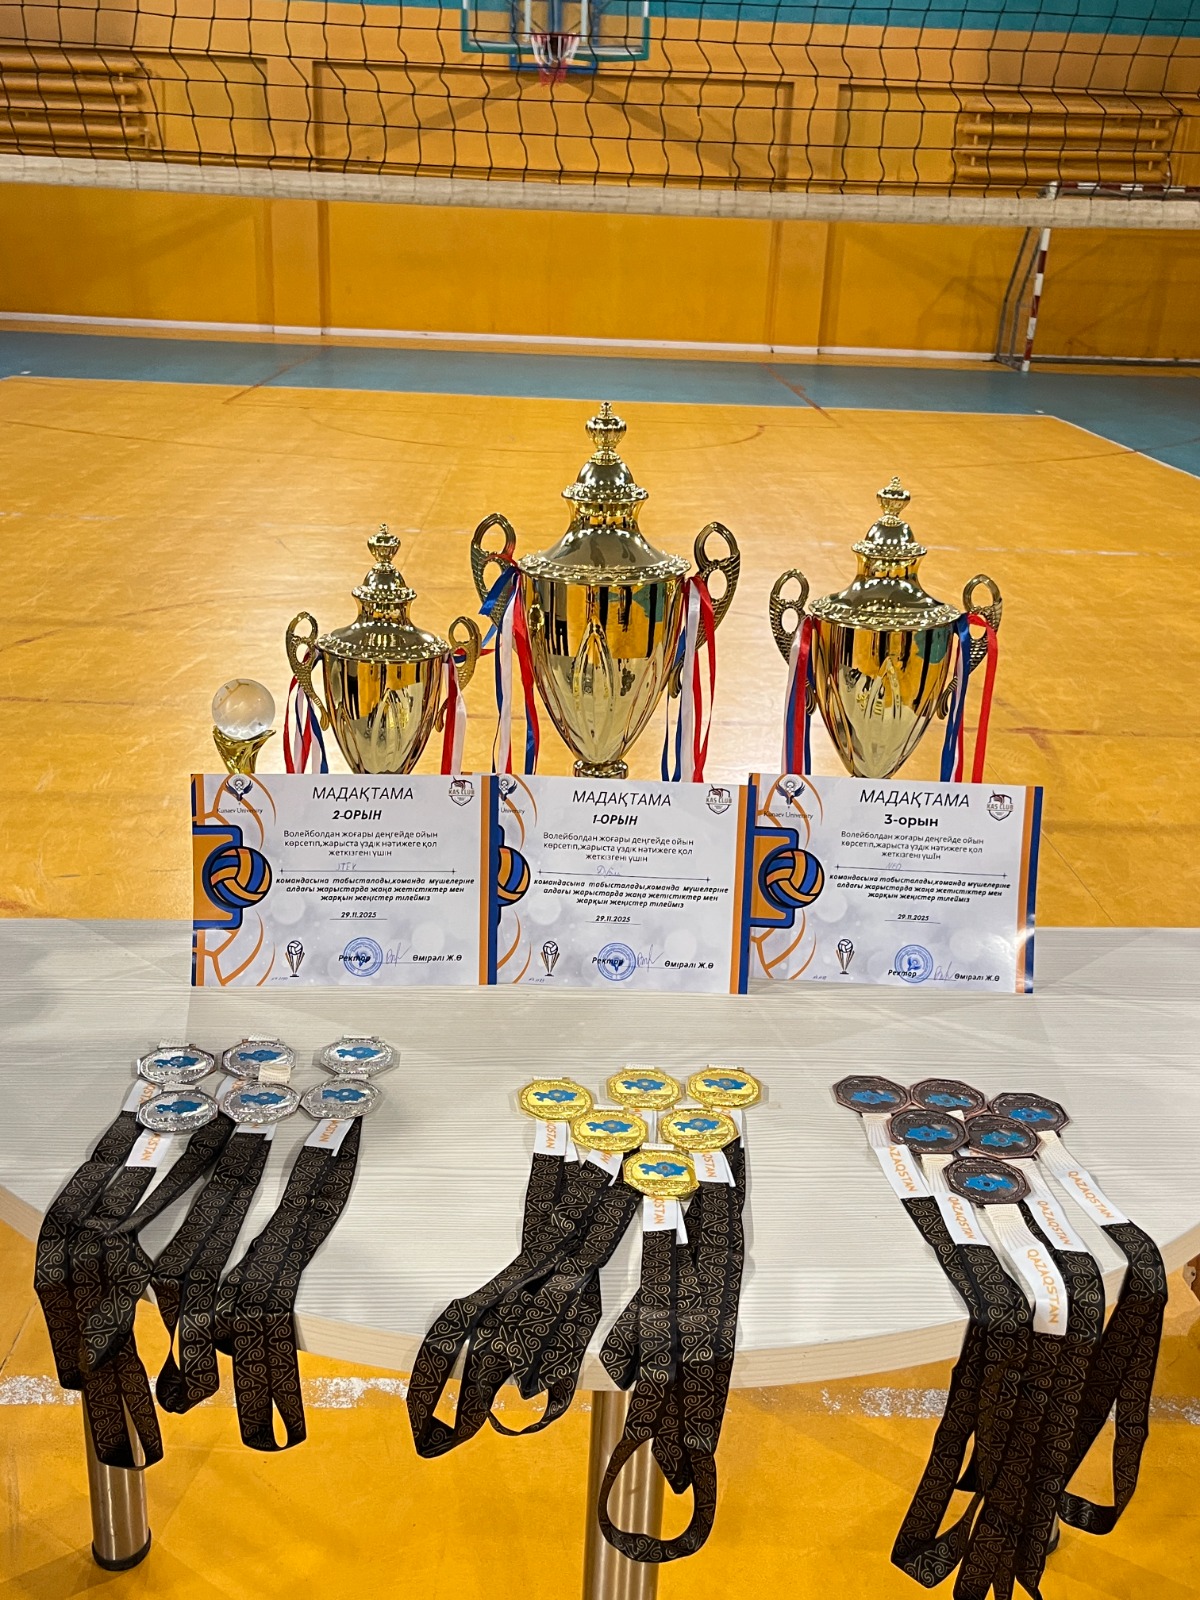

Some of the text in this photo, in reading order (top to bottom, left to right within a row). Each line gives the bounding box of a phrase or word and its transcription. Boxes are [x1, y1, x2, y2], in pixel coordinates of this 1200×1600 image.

[312, 787, 414, 802] МАДАҚТАМА
[572, 790, 671, 807] МАДАҚТАМА
[860, 789, 970, 808] МАДАҚТАМА
[332, 810, 382, 820] 2-ОРЫН
[592, 814, 638, 825] 1-ОРЫН
[884, 814, 939, 828] 3-орын
[283, 830, 438, 840] Волейболдан жоғары деңгейде ойын
[543, 832, 694, 846] Волейболдан жоғары деңгейде ойын
[841, 831, 984, 845] Волейболдан жоғары деңгейде ойын
[360, 841, 380, 849] үздік
[422, 841, 437, 849] қол
[616, 846, 637, 854] үздік
[638, 847, 677, 855] нәтижеге
[910, 844, 930, 852] үздік
[931, 845, 967, 853] нәтижеге
[372, 850, 392, 858] үшін
[881, 851, 921, 859] жеткізгені
[429, 878, 475, 886] мүшелеріне
[533, 879, 585, 887] командасына
[683, 886, 729, 894] мүшелеріне
[829, 873, 878, 882] командасына
[967, 882, 1011, 890] мүшелеріне
[317, 886, 369, 894] жарыстарда
[573, 890, 623, 898] жарыстарда
[625, 892, 646, 900] жаңа
[648, 893, 701, 902] жетістіктер
[864, 884, 913, 892] жарыстарда
[936, 888, 987, 896] жетістіктер
[867, 892, 970, 903] жарқын жеңістер тілейміз
[610, 900, 648, 908] жеңістер
[889, 1145, 917, 1192] AZAQSTAN
[1068, 1170, 1115, 1219] QAZAQSTAN
[948, 1196, 977, 1241] QAZAQSTAN
[1037, 1200, 1074, 1246] QAZAQSTAN
[1027, 1248, 1060, 1324] QAZAQSTAN
